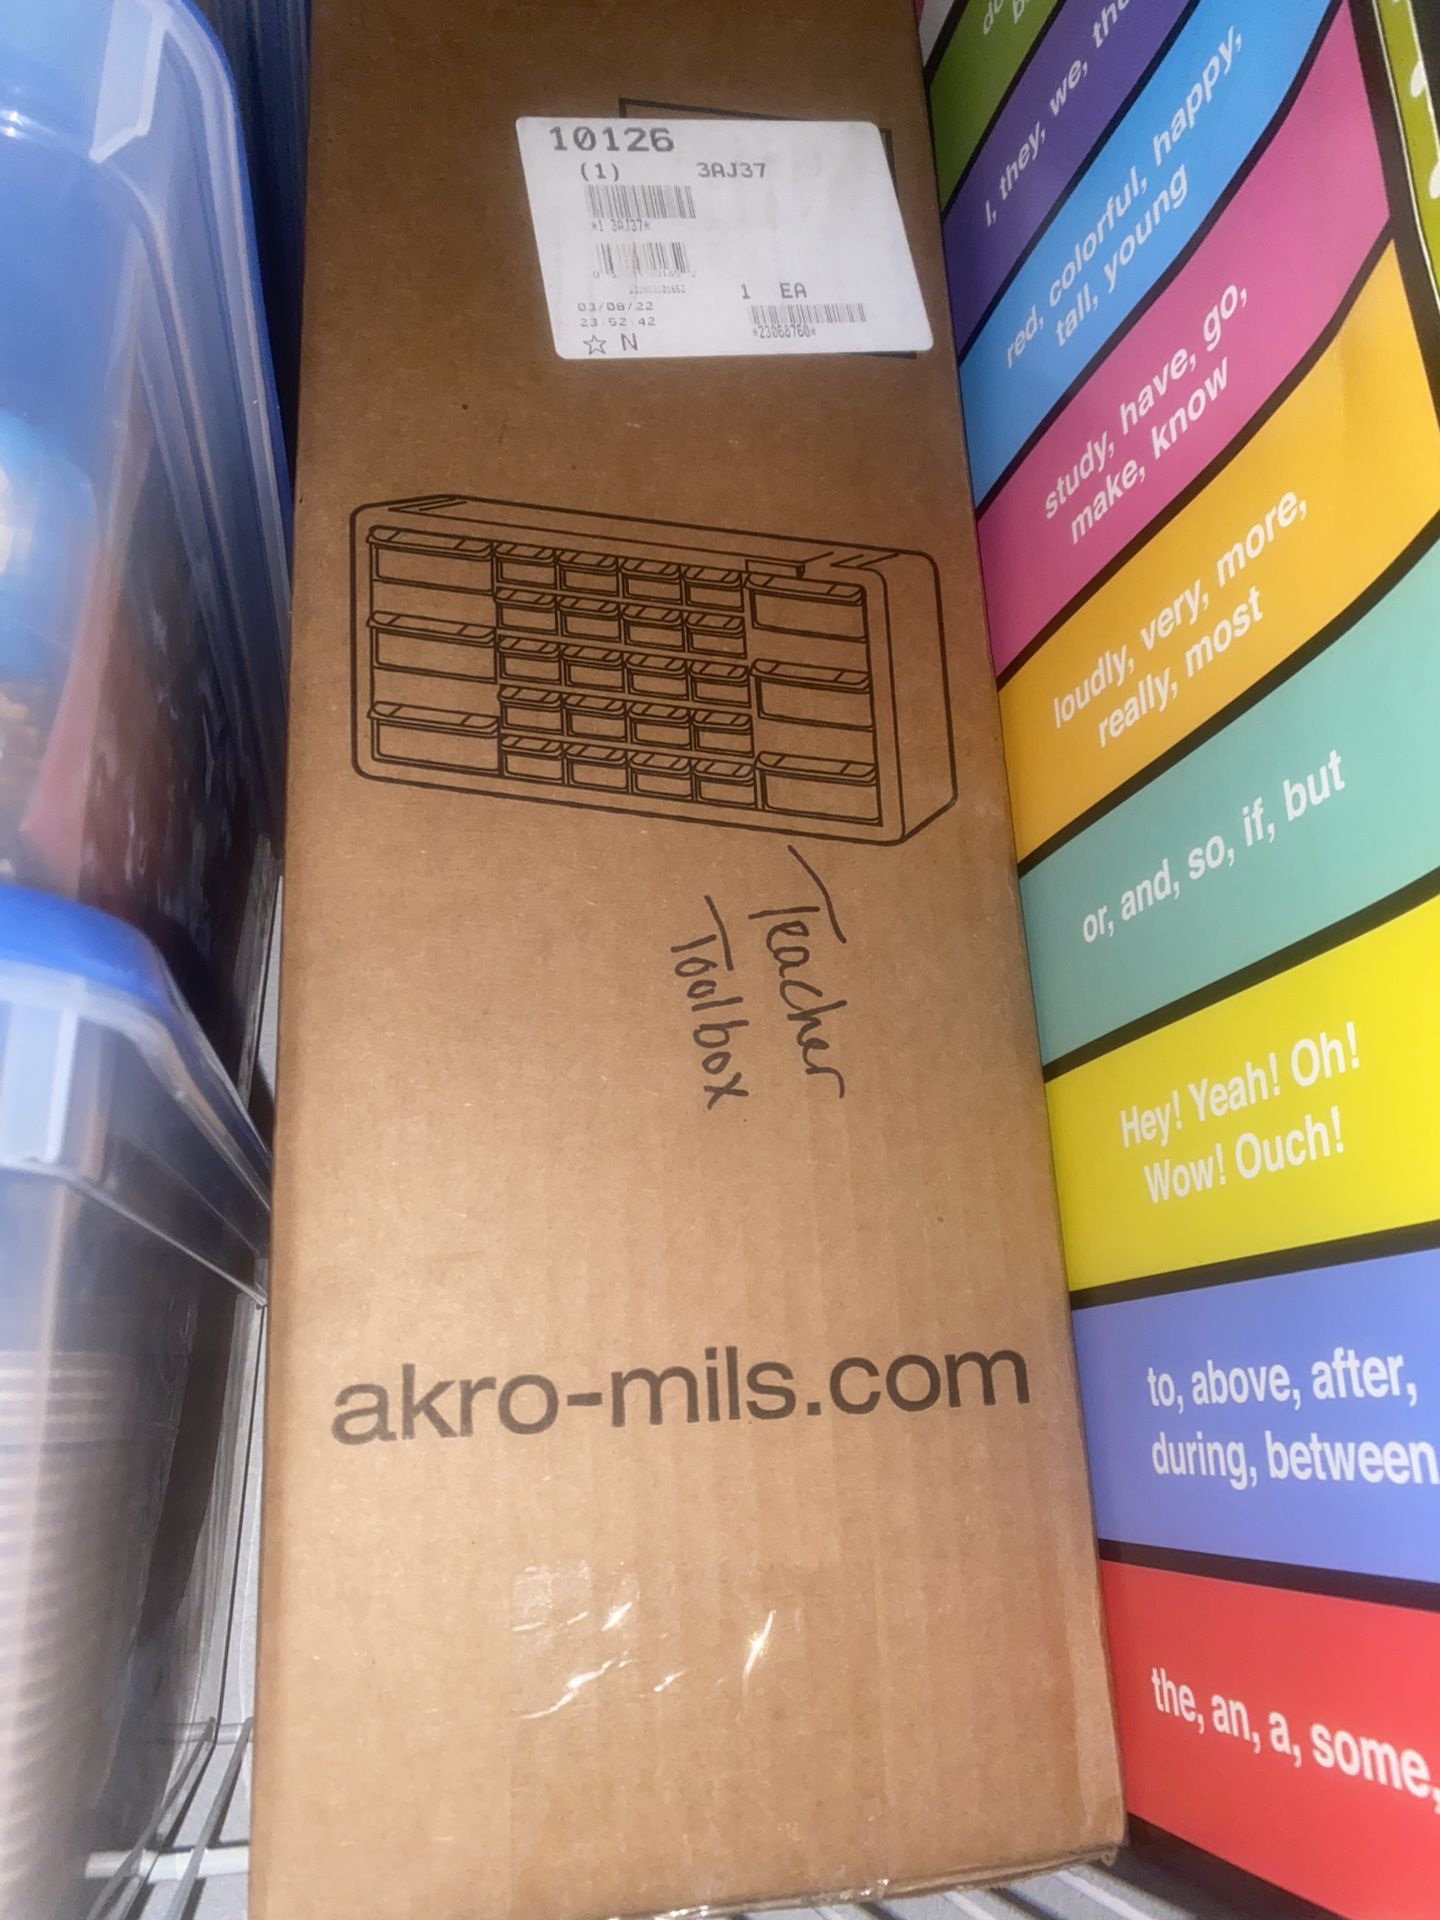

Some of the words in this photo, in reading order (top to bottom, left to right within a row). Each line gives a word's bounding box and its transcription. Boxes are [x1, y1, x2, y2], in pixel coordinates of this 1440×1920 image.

[550, 125, 675, 153] 10126
[580, 162, 621, 181] (1)
[697, 162, 766, 179] 3AJ37
[999, 122, 1046, 200] they,
[1050, 59, 1088, 116] we,
[1004, 310, 1045, 368] red,
[1048, 166, 1148, 307] colorful,
[1152, 25, 1242, 168] happy,
[1056, 284, 1099, 347] tall,
[1104, 164, 1189, 294] young
[620, 332, 639, 351] N
[740, 283, 751, 300] 1
[780, 282, 807, 299] EA
[1045, 431, 1115, 519] study,
[1119, 347, 1197, 435] have,
[1202, 284, 1248, 352] go,
[1070, 457, 1146, 544] make,
[1151, 357, 1228, 459] know
[1053, 642, 1134, 729] loudly,
[1140, 578, 1209, 652] very,
[1216, 491, 1307, 586] more,
[1098, 667, 1178, 748] really,
[1185, 584, 1263, 679] most
[1083, 905, 1115, 943] or,
[1120, 859, 1180, 921] and,
[1188, 834, 1235, 880] so,
[1242, 798, 1276, 847] if,
[1283, 749, 1346, 824] but
[670, 894, 750, 1111] Toolbox
[748, 844, 848, 1099] Teacher
[1120, 1091, 1183, 1149] Hey!
[1188, 1052, 1281, 1124] Yeah!
[1290, 1020, 1360, 1087] Oh!
[1144, 1143, 1227, 1204] Wow!
[1235, 1105, 1345, 1181] Ouch!
[331, 1346, 1031, 1445] akro-mils.com
[1147, 1366, 1184, 1414] to,
[1192, 1360, 1301, 1410] above,
[1311, 1347, 1418, 1407] after,
[1151, 1432, 1257, 1490] during,
[1265, 1431, 1440, 1486] between
[1151, 1667, 1205, 1734] the,
[1212, 1694, 1261, 1754] an,
[1270, 1712, 1302, 1768] a,
